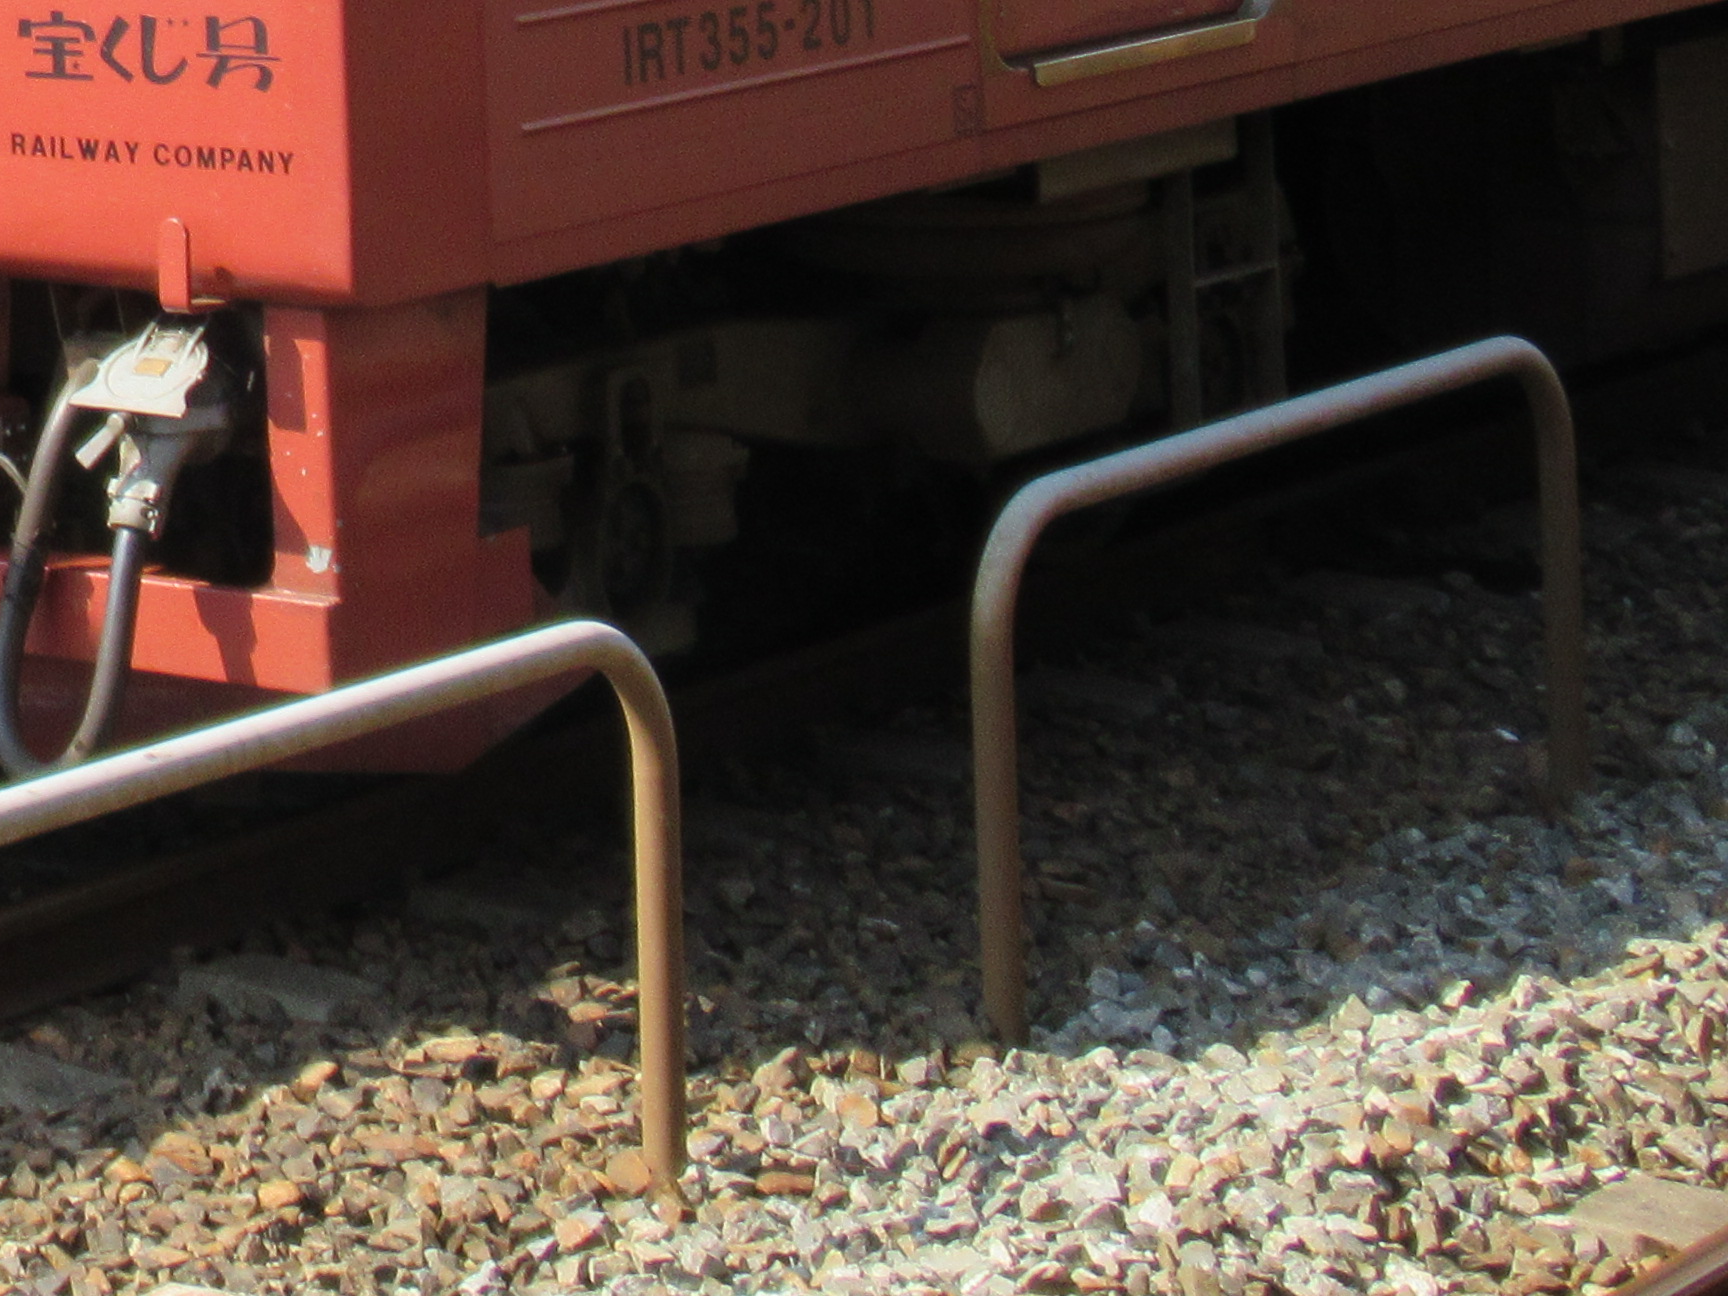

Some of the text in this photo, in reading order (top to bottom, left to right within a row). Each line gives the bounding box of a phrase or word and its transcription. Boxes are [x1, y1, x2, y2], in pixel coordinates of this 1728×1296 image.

[17, 10, 282, 93] 宝くじ号
[10, 132, 141, 166] RAILWAY
[152, 143, 295, 176] COMPANY
